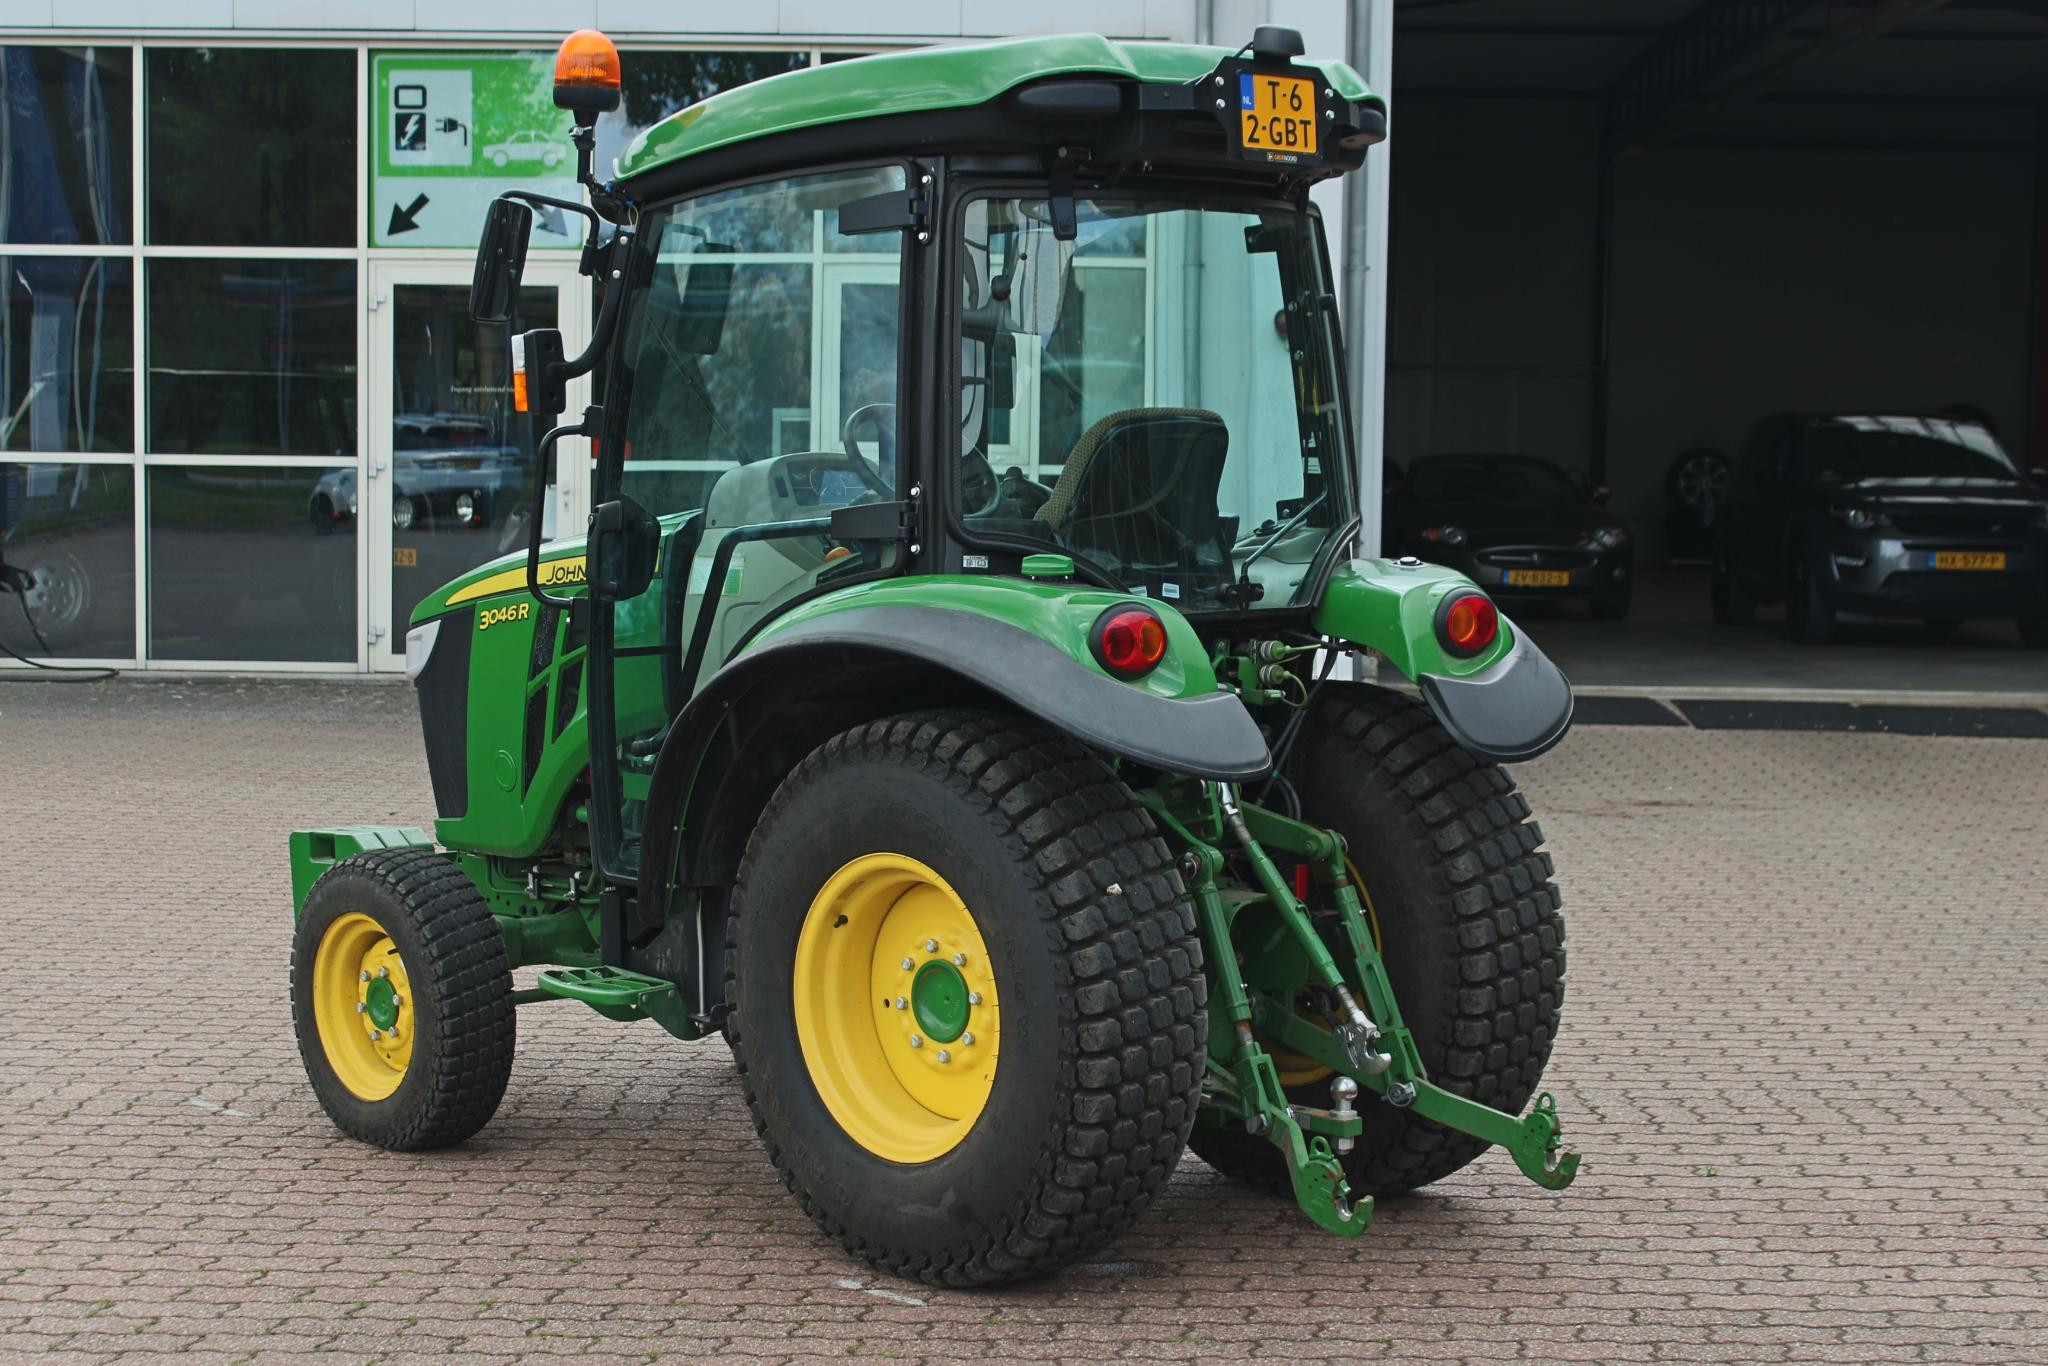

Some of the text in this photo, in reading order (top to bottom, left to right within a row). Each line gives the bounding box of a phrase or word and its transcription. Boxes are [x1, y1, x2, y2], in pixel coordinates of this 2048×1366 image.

[1242, 95, 1252, 105] NL
[1267, 80, 1302, 112] T-6
[1246, 114, 1311, 148] 2-GBT
[1939, 552, 1999, 567] HX-577-P
